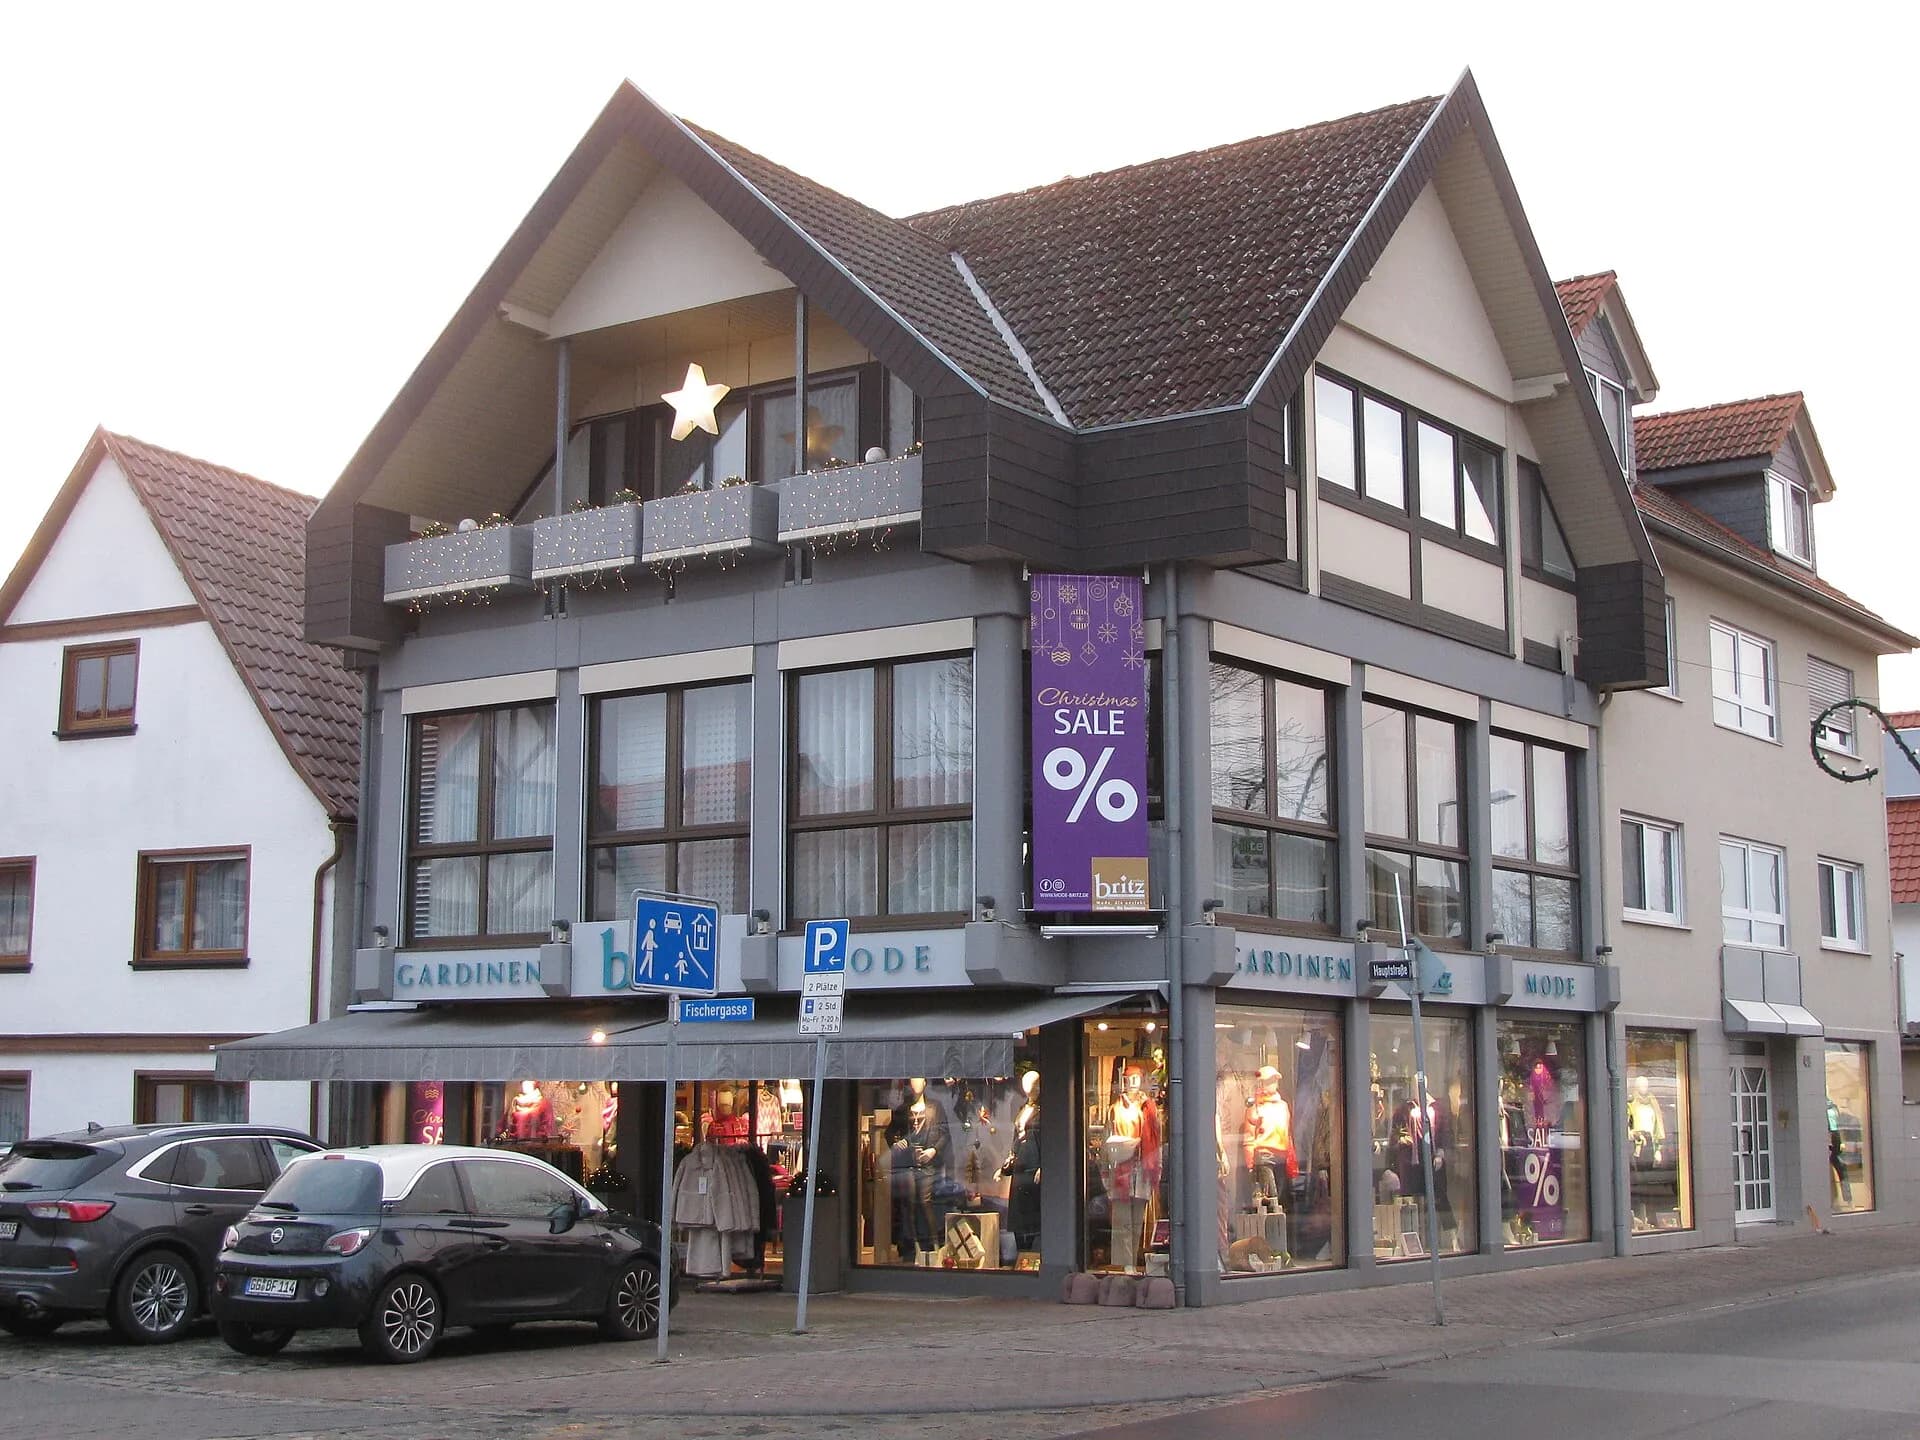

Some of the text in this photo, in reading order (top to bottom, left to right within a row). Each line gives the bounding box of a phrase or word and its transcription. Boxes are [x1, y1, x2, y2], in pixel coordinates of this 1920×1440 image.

[1037, 687, 1139, 707] Christmas
[1054, 708, 1125, 735] SALE
[1042, 746, 1139, 823] %
[1094, 872, 1145, 899] britz
[813, 927, 838, 967] P
[850, 945, 931, 974] ODE
[398, 961, 541, 987] GARDINEN
[1235, 946, 1351, 981] ARDINEN
[1373, 964, 1409, 978] Hauptstraße
[808, 982, 838, 992] 2 Plätze
[1526, 972, 1576, 998] MODE
[685, 1003, 748, 1020] Fischergasse
[422, 1125, 444, 1146] SA
[1527, 1127, 1556, 1149] SALE
